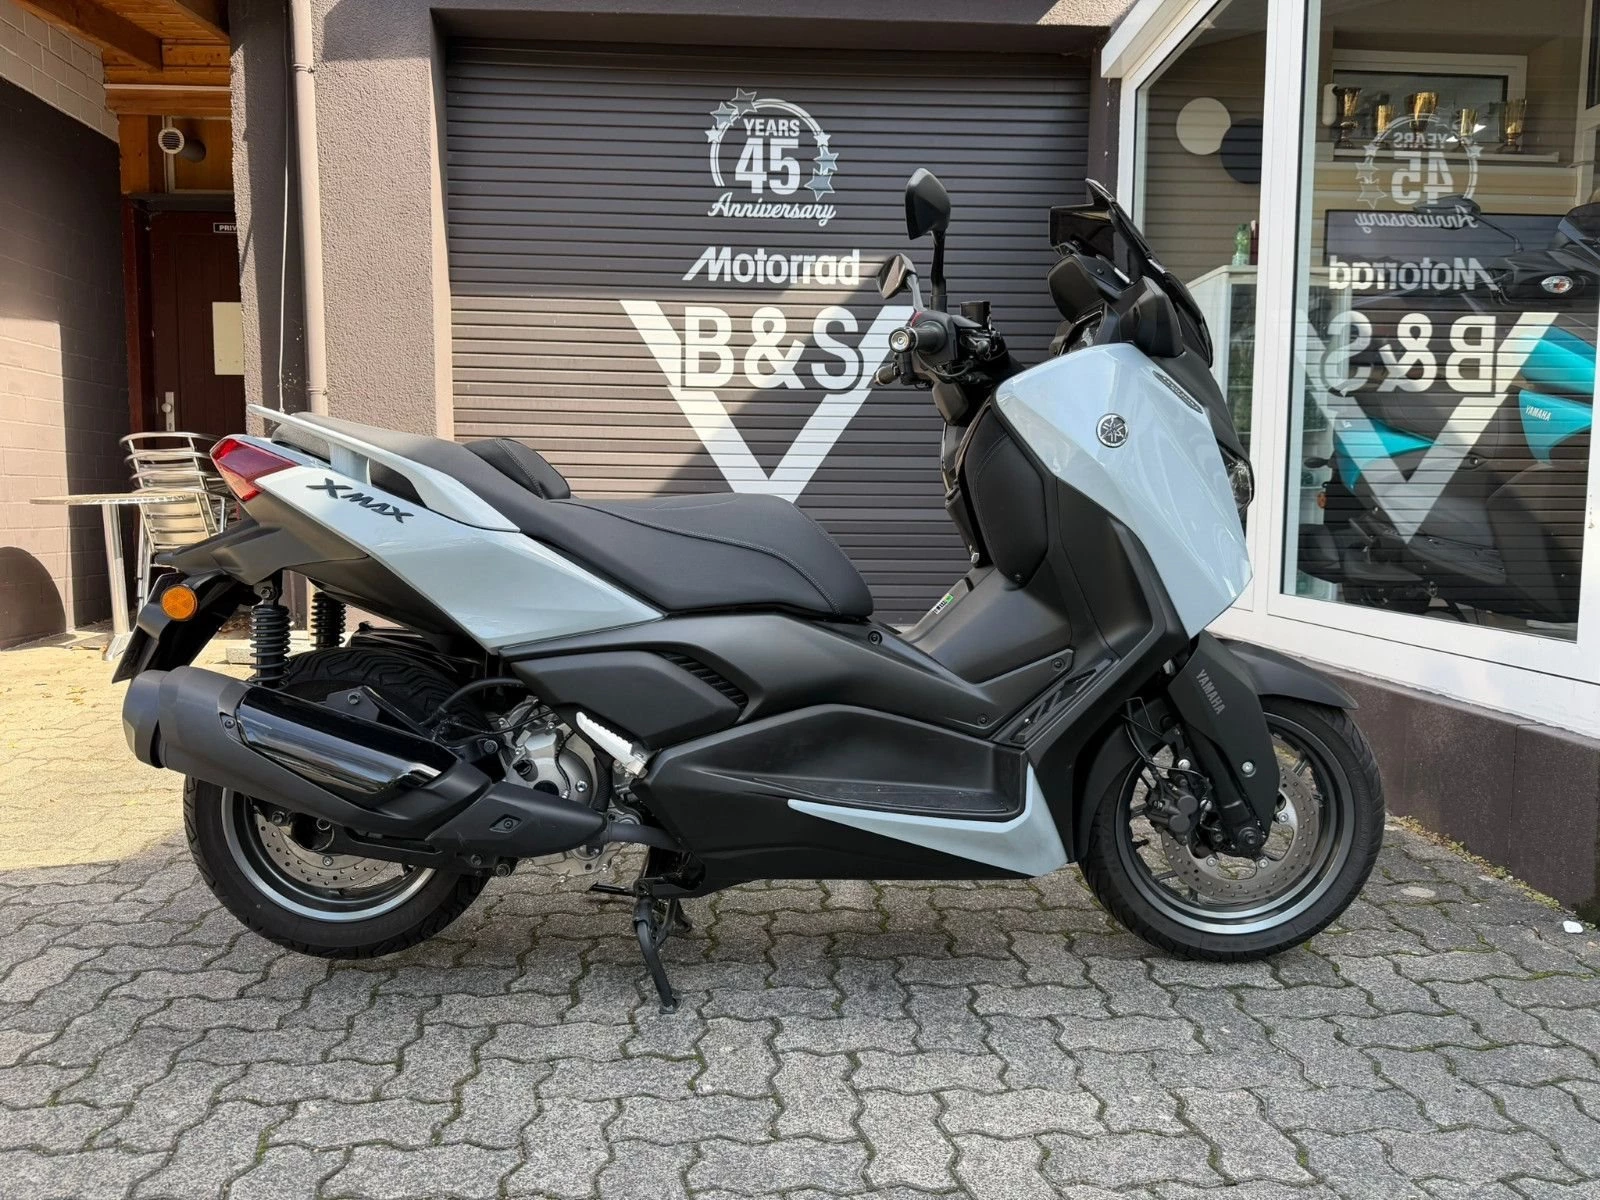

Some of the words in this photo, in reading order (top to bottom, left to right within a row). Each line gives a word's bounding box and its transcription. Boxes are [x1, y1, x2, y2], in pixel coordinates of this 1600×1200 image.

[743, 118, 800, 137] YEARS
[734, 138, 801, 195] 45
[707, 191, 837, 227] Anniversary
[682, 246, 860, 286] Motorrad
[1525, 404, 1552, 422] YAMAHA
[1195, 669, 1226, 715] YAMAHA
